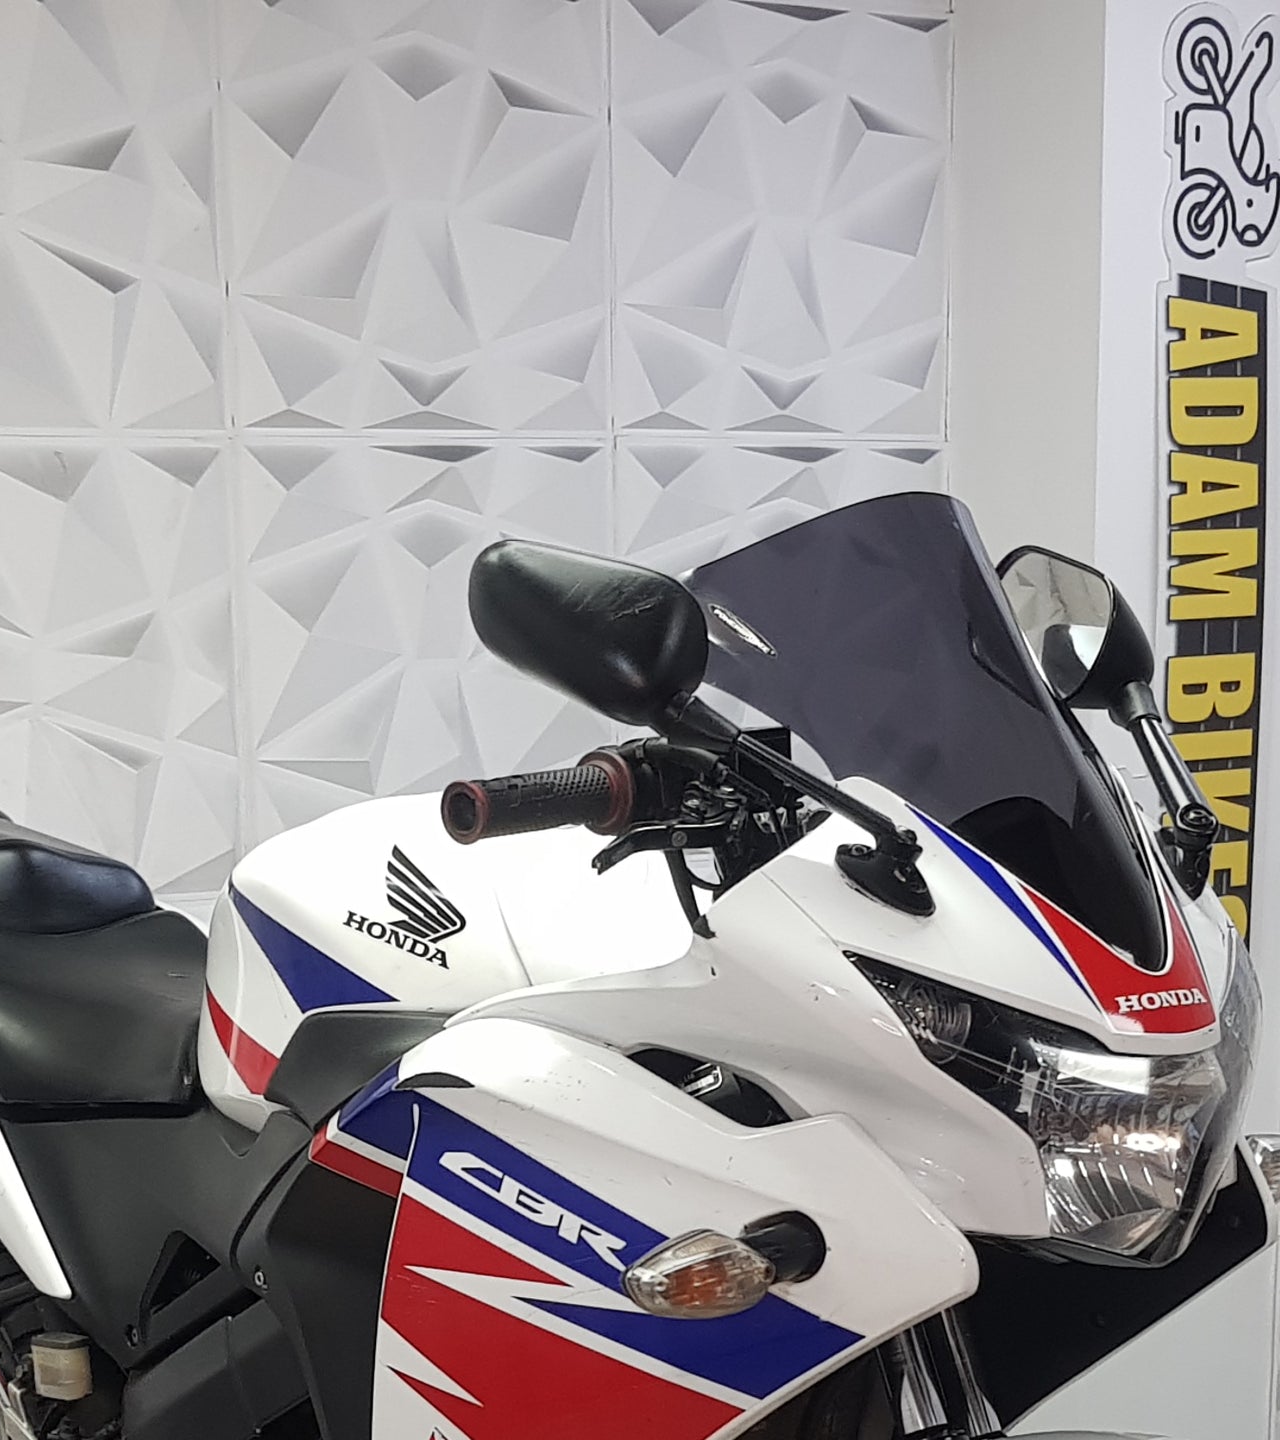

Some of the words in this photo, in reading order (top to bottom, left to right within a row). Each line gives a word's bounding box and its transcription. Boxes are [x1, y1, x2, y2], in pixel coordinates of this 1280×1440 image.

[1169, 296, 1258, 620] ADAM
[1163, 653, 1257, 938] BIK
[342, 910, 450, 970] HONDA
[1114, 987, 1207, 1014] HONDA
[438, 1151, 628, 1272] CBR
